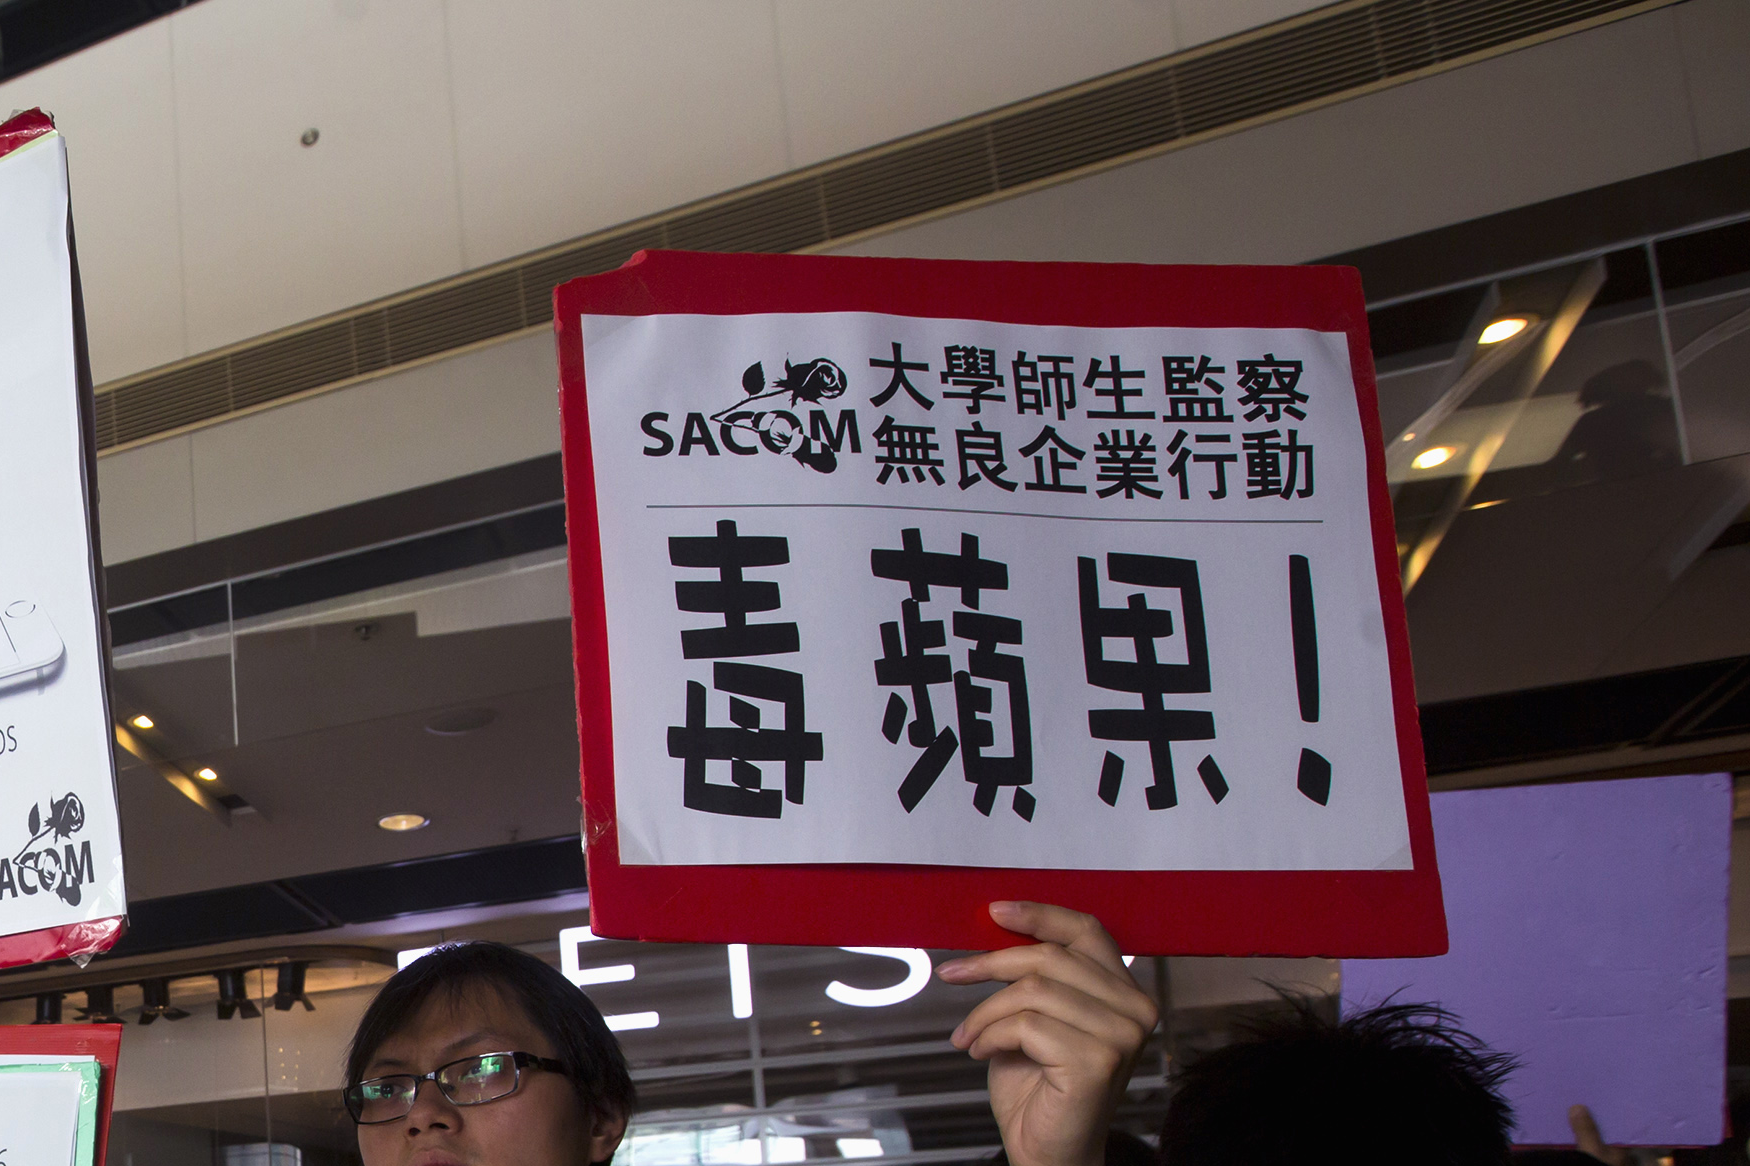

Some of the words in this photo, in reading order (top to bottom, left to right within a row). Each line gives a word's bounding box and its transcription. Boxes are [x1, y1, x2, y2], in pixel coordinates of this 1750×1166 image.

[868, 342, 1310, 424] 大學師生監察
[641, 408, 863, 457] SACOM
[872, 421, 1316, 501] 無良企業行動
